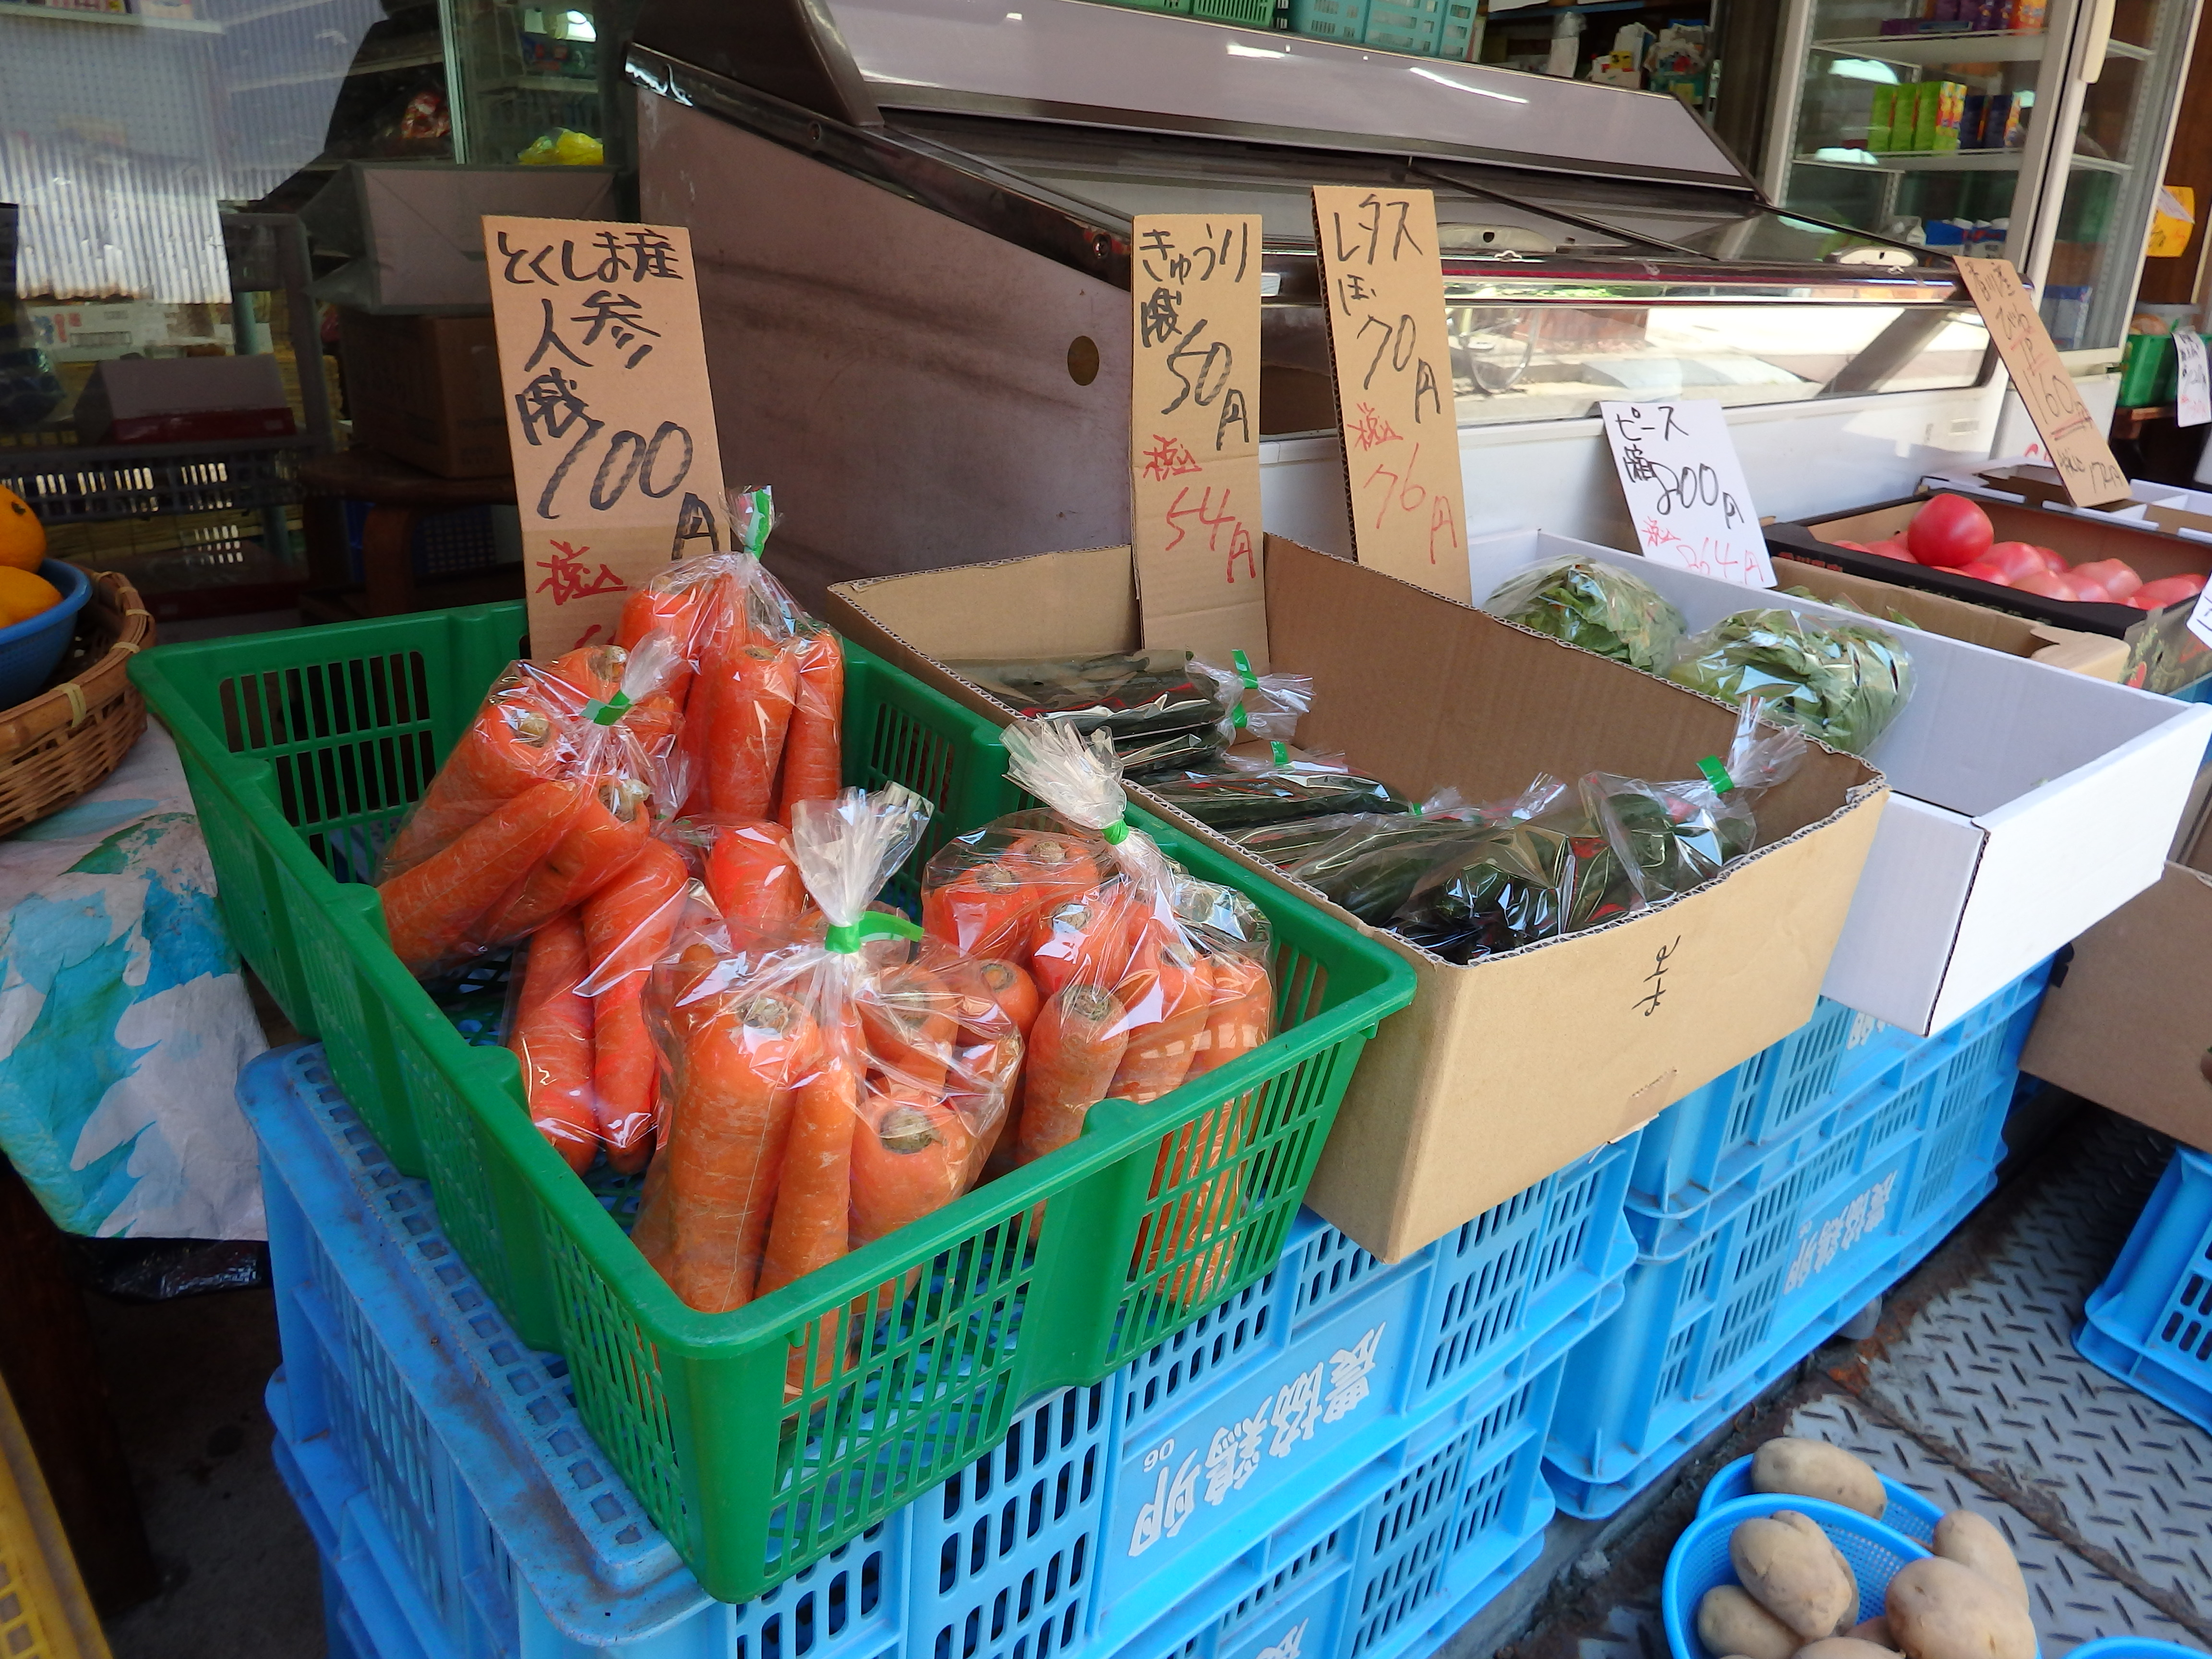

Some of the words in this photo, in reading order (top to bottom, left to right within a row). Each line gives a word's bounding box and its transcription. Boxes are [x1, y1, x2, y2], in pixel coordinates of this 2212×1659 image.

[498, 228, 684, 286] とくしま産
[1140, 221, 1248, 285] きゅうり
[1333, 193, 1423, 265] レタス
[524, 290, 661, 373] 人参
[1615, 406, 1689, 441] ピース
[1128, 1321, 1386, 1557] 農協鶏卵
